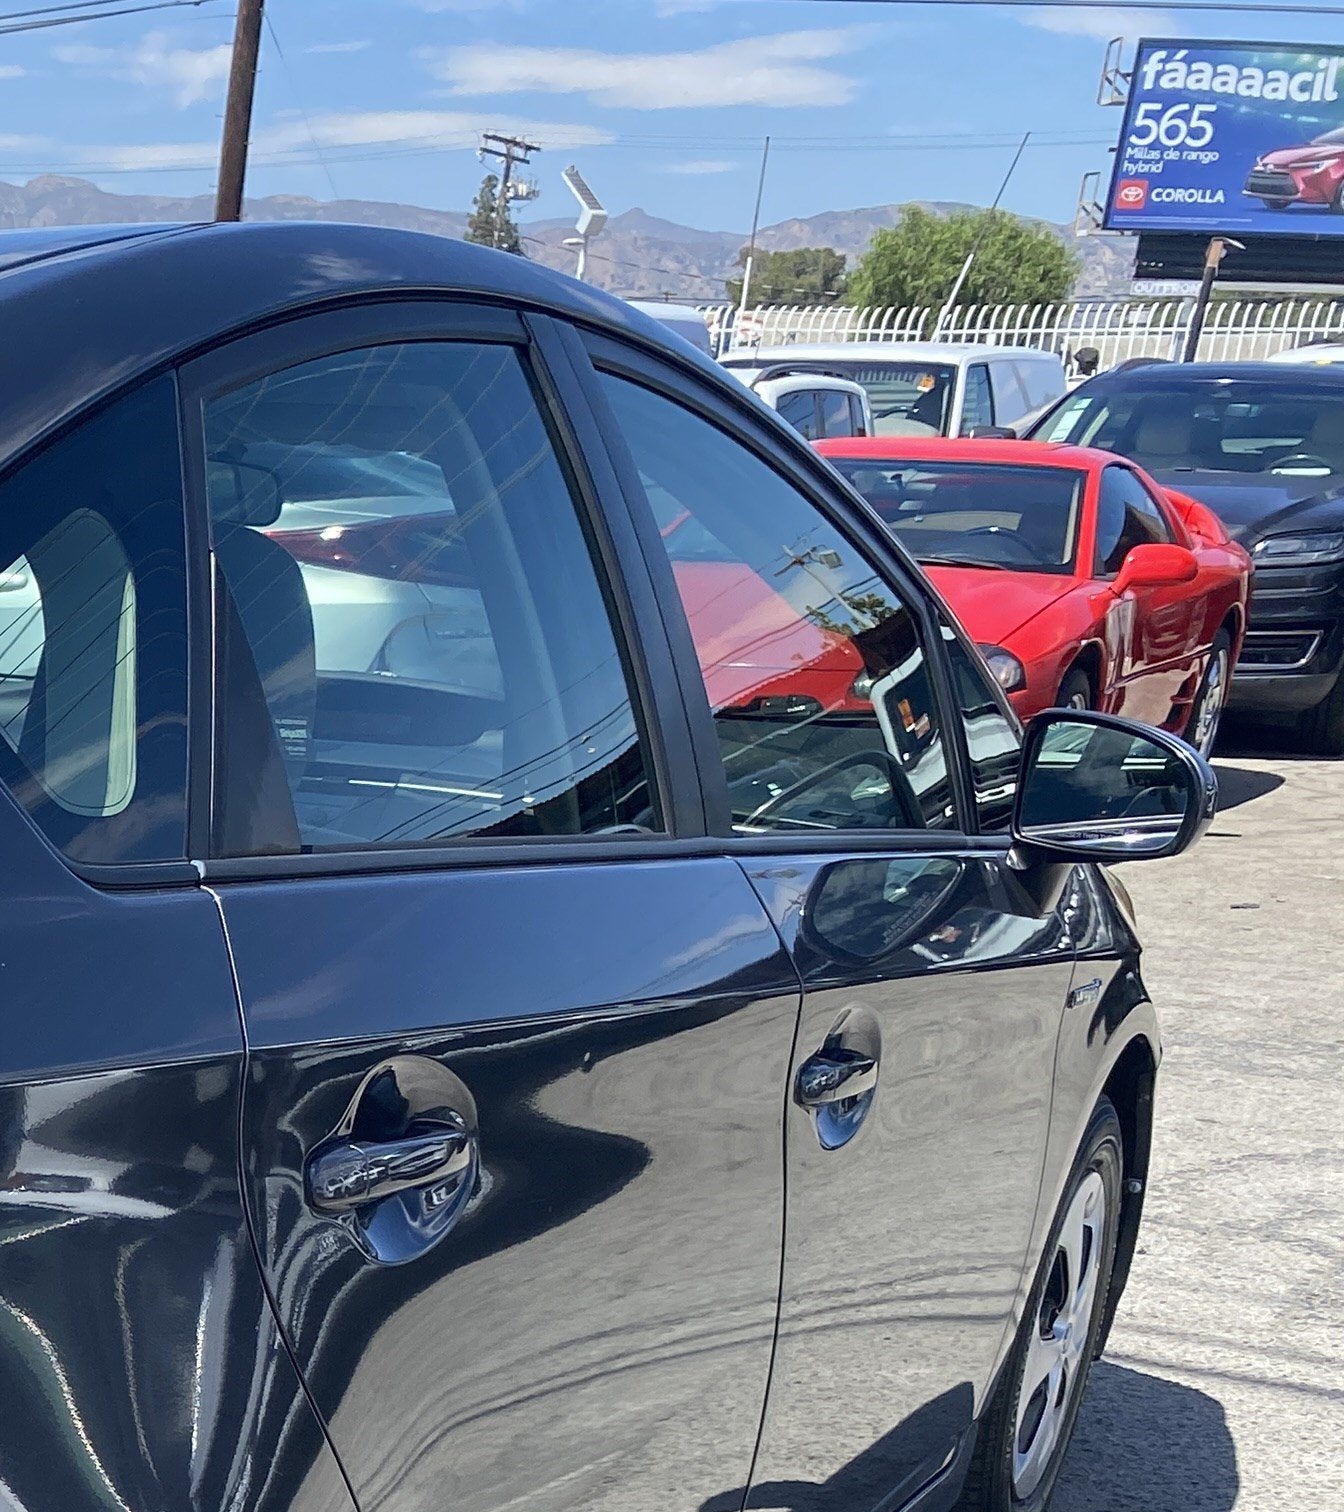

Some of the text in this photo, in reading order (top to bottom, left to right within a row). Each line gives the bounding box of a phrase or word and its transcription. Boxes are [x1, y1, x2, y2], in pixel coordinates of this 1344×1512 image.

[1142, 49, 1339, 102] fáaaaacil
[1129, 102, 1218, 147] 565
[1125, 146, 1220, 165] Millas de rango
[1122, 161, 1163, 174] hybrid
[1151, 187, 1225, 204] COROLLA
